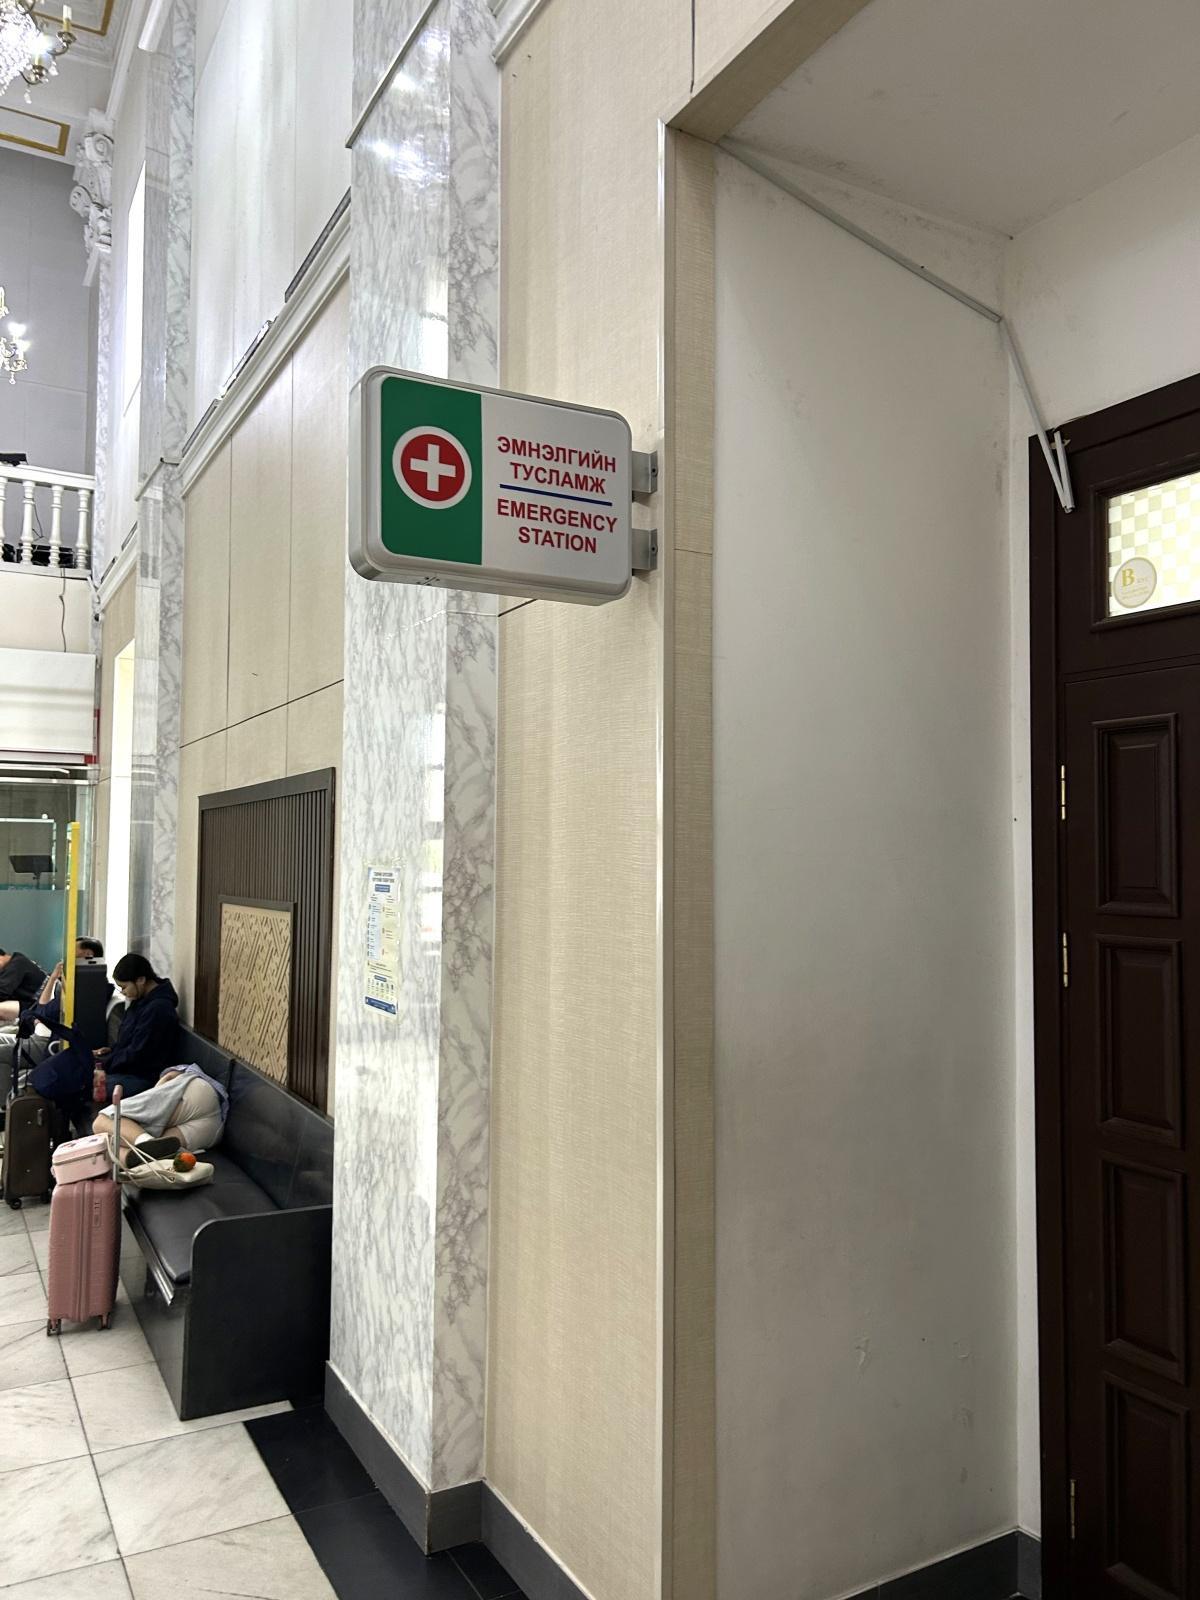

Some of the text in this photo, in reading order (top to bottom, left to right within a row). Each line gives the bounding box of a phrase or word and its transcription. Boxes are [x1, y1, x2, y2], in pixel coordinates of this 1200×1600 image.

[497, 436, 616, 473] ЭМНЭЛГИЙН
[510, 462, 606, 494] ТУСЛАМЖ
[497, 498, 618, 533] EMERGENCY
[518, 526, 597, 553] STATION
[1121, 568, 1135, 587] B
